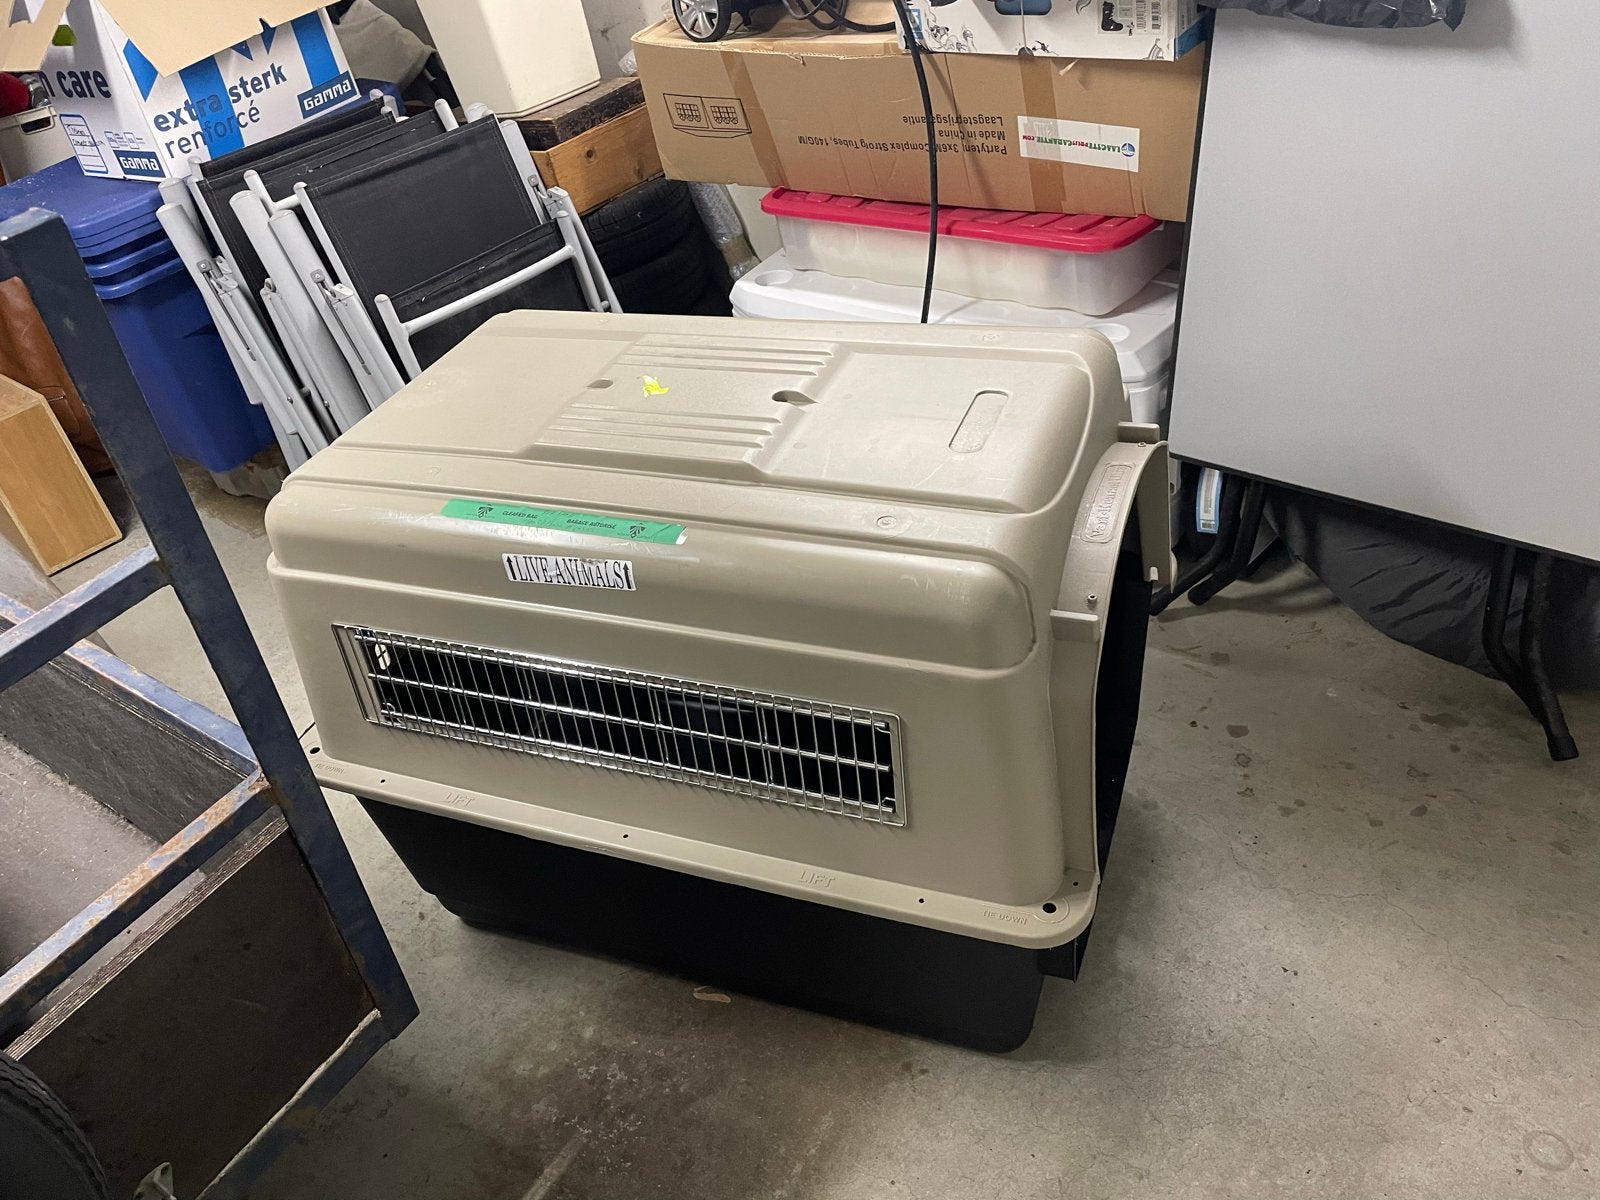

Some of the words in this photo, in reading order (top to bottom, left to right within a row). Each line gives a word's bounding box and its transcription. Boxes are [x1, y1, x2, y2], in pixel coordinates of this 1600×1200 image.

[56, 70, 112, 98] care
[153, 94, 224, 132] extra
[228, 62, 287, 104] sterk
[902, 115, 1003, 126] Laagsteprijsgaantie
[164, 99, 260, 159] renforcé
[938, 129, 965, 140] China
[967, 130, 977, 140] in
[978, 130, 1006, 141] Made
[512, 555, 553, 583] LIVE
[555, 557, 625, 589] ANIMALS
[444, 792, 475, 807] LIFT
[800, 871, 836, 888] LIFT
